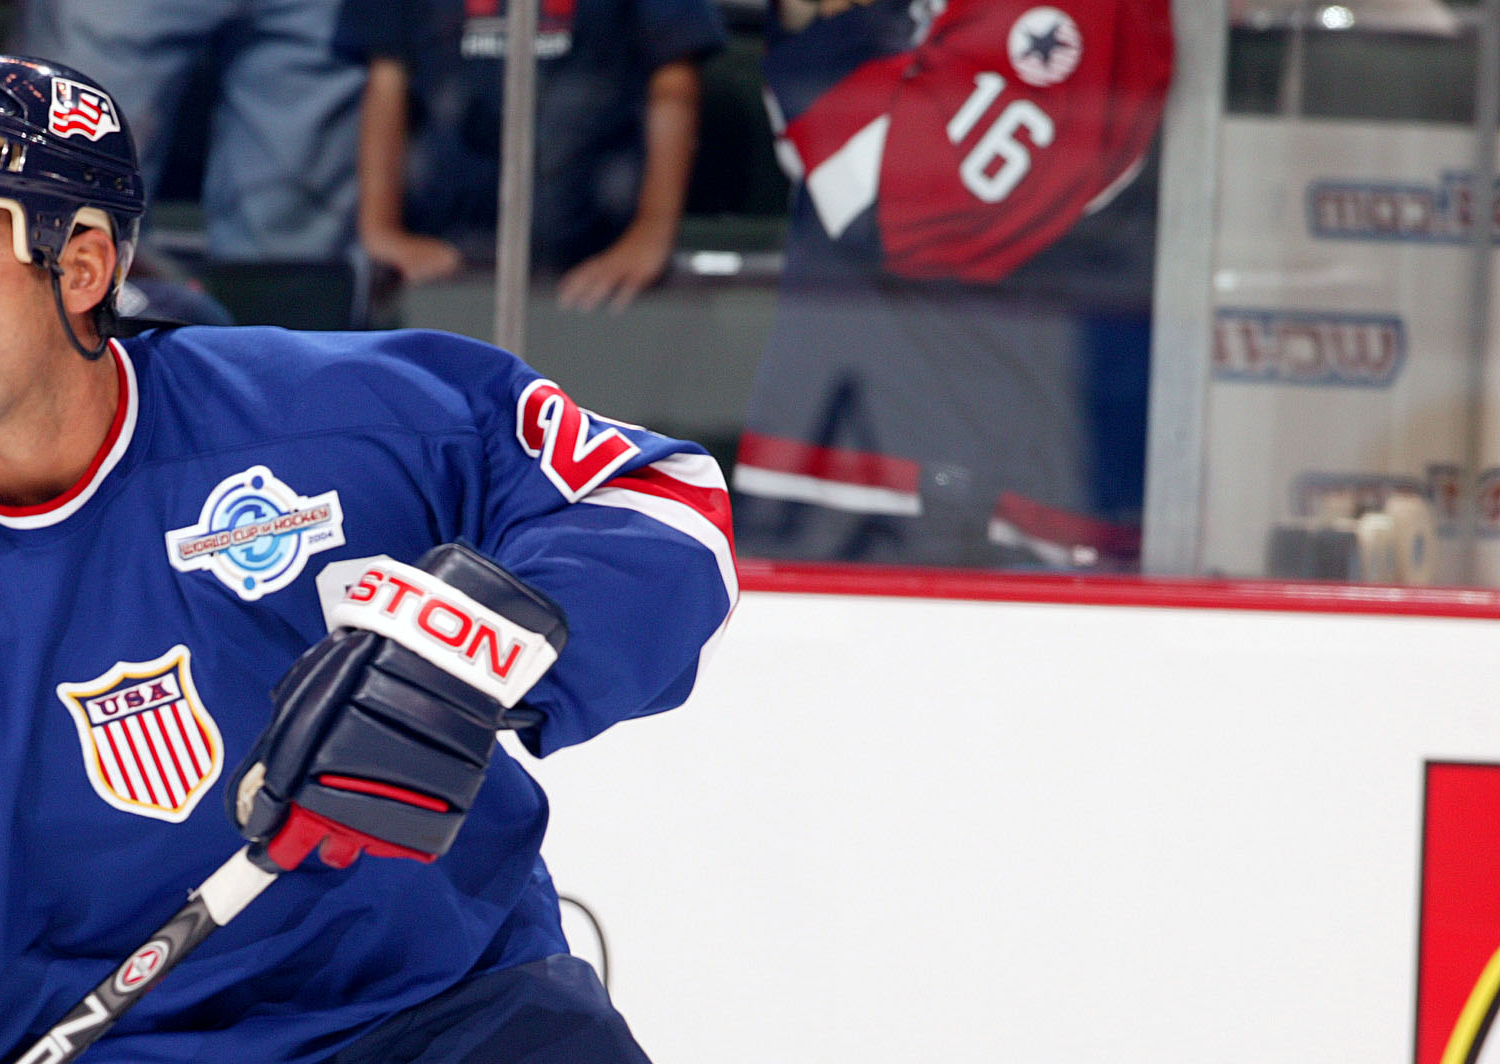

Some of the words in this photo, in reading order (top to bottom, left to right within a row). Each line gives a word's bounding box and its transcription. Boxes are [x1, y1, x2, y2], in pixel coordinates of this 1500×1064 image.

[946, 70, 1057, 204] 16
[179, 532, 231, 556] WORLD
[232, 525, 259, 543] CUP
[274, 508, 329, 531] HOCKEY
[307, 531, 334, 544] 2004
[93, 682, 173, 715] USA
